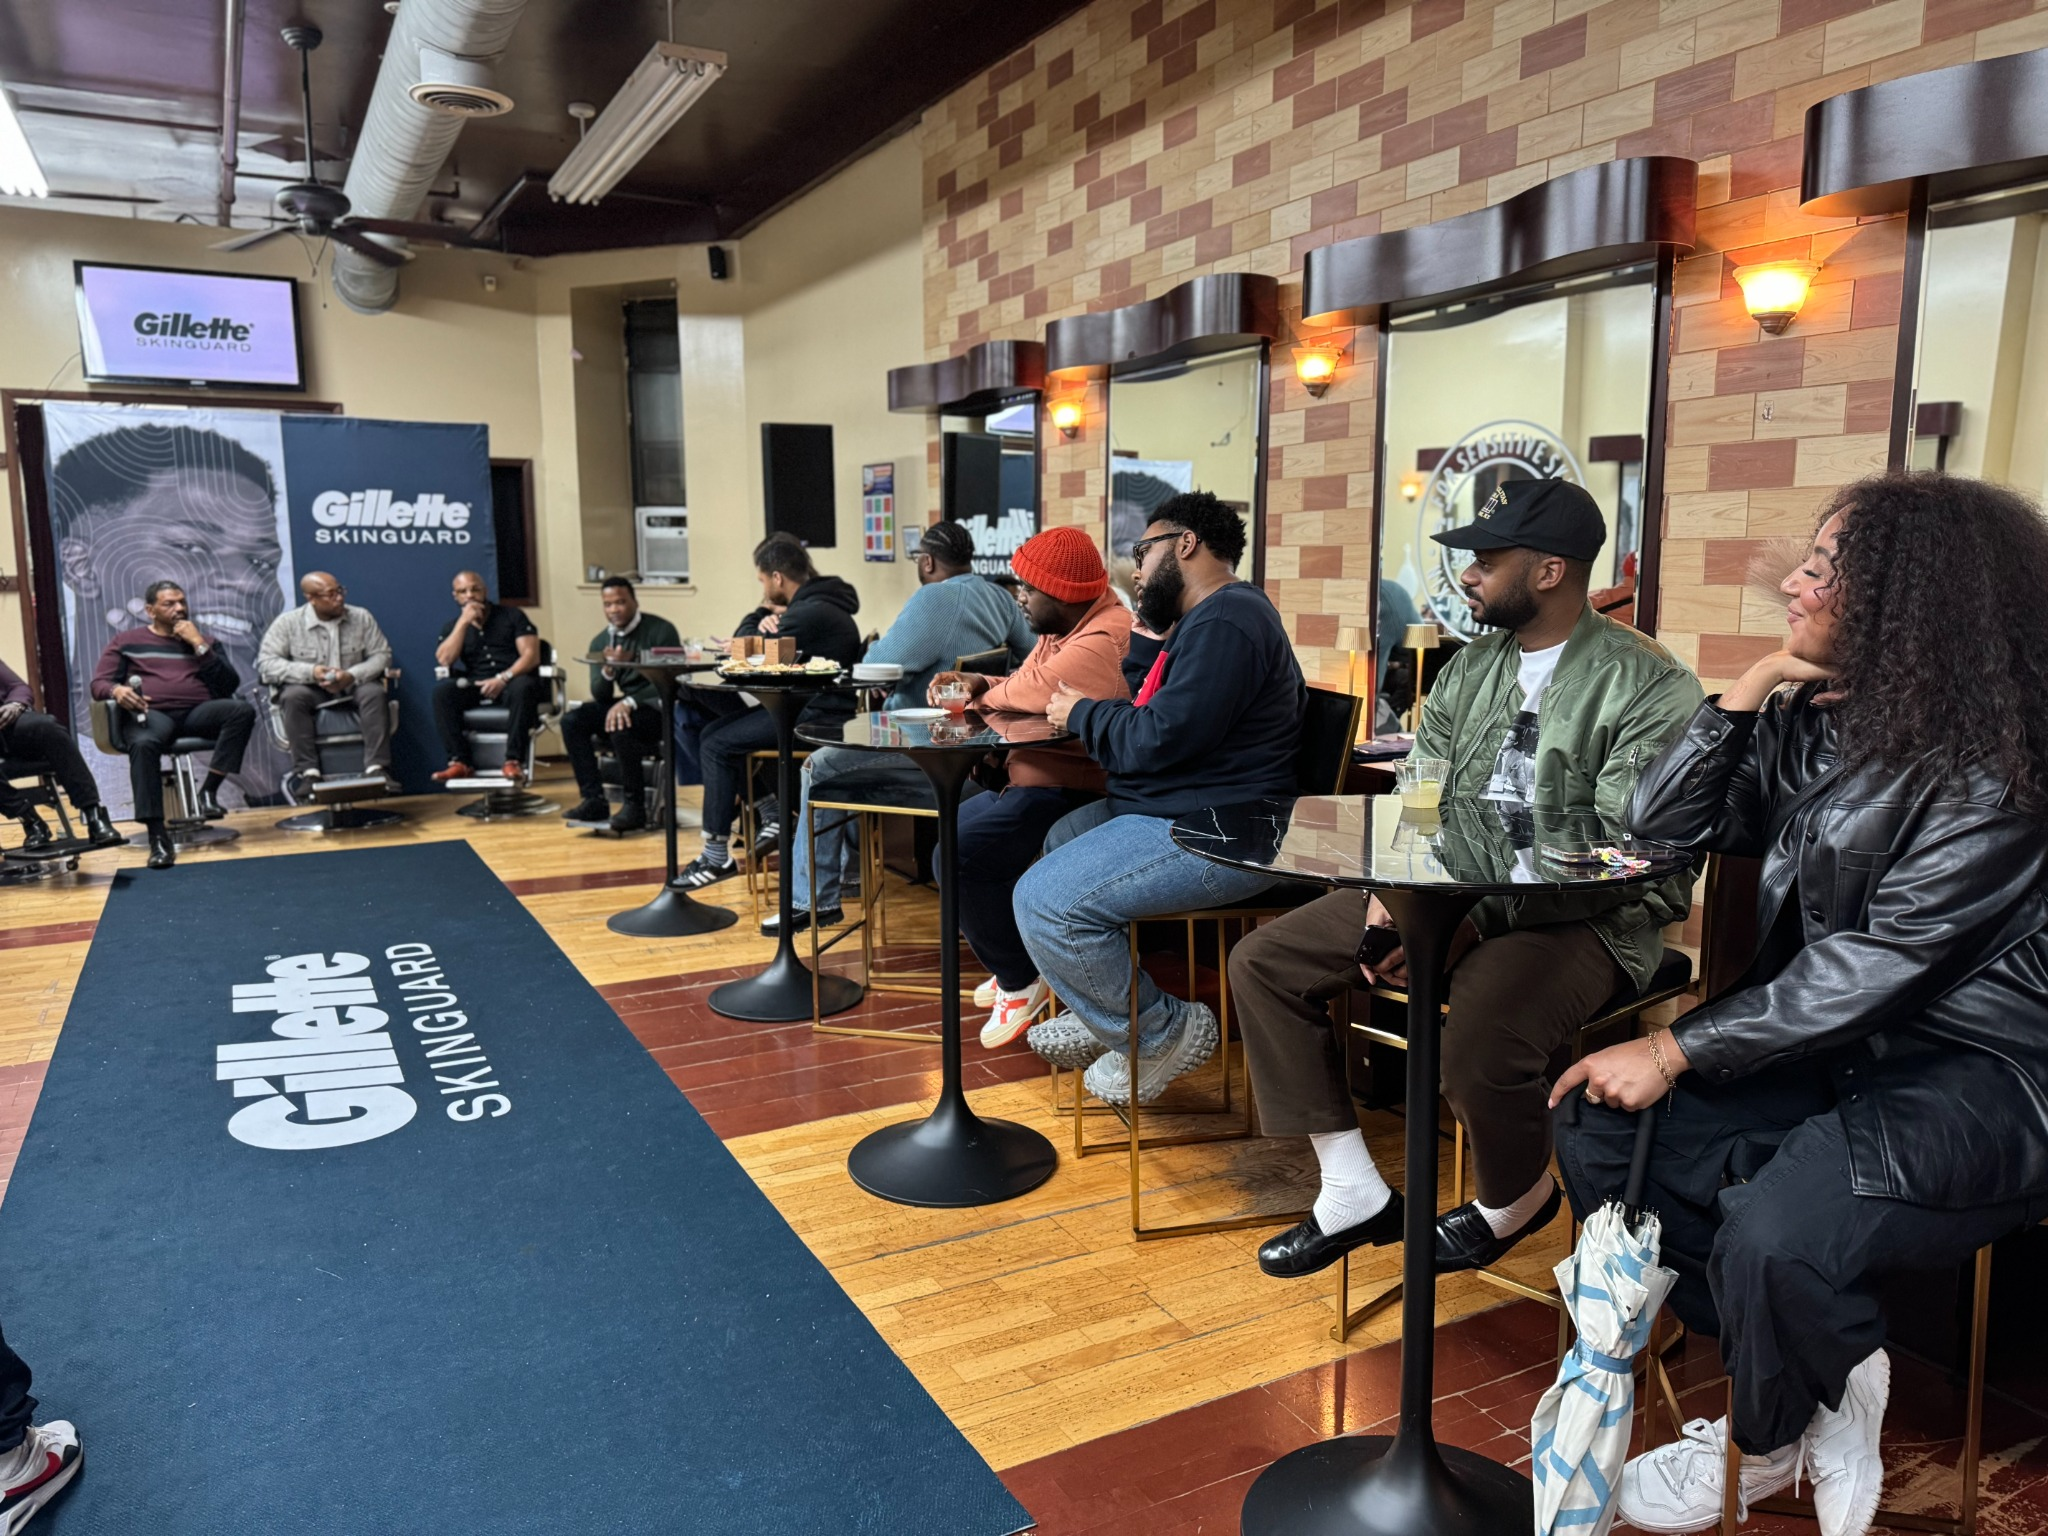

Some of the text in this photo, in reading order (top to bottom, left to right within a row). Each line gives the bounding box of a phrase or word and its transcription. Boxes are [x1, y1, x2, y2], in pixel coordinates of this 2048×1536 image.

[134, 312, 254, 341] Gillette
[136, 337, 251, 352] SKINGUARD
[1456, 431, 1548, 472] SENSITIVE
[312, 489, 472, 528] Gillette
[315, 529, 471, 544] SKINGUARD
[216, 952, 418, 1150] Gillette
[385, 943, 512, 1122] SKINGUARD
